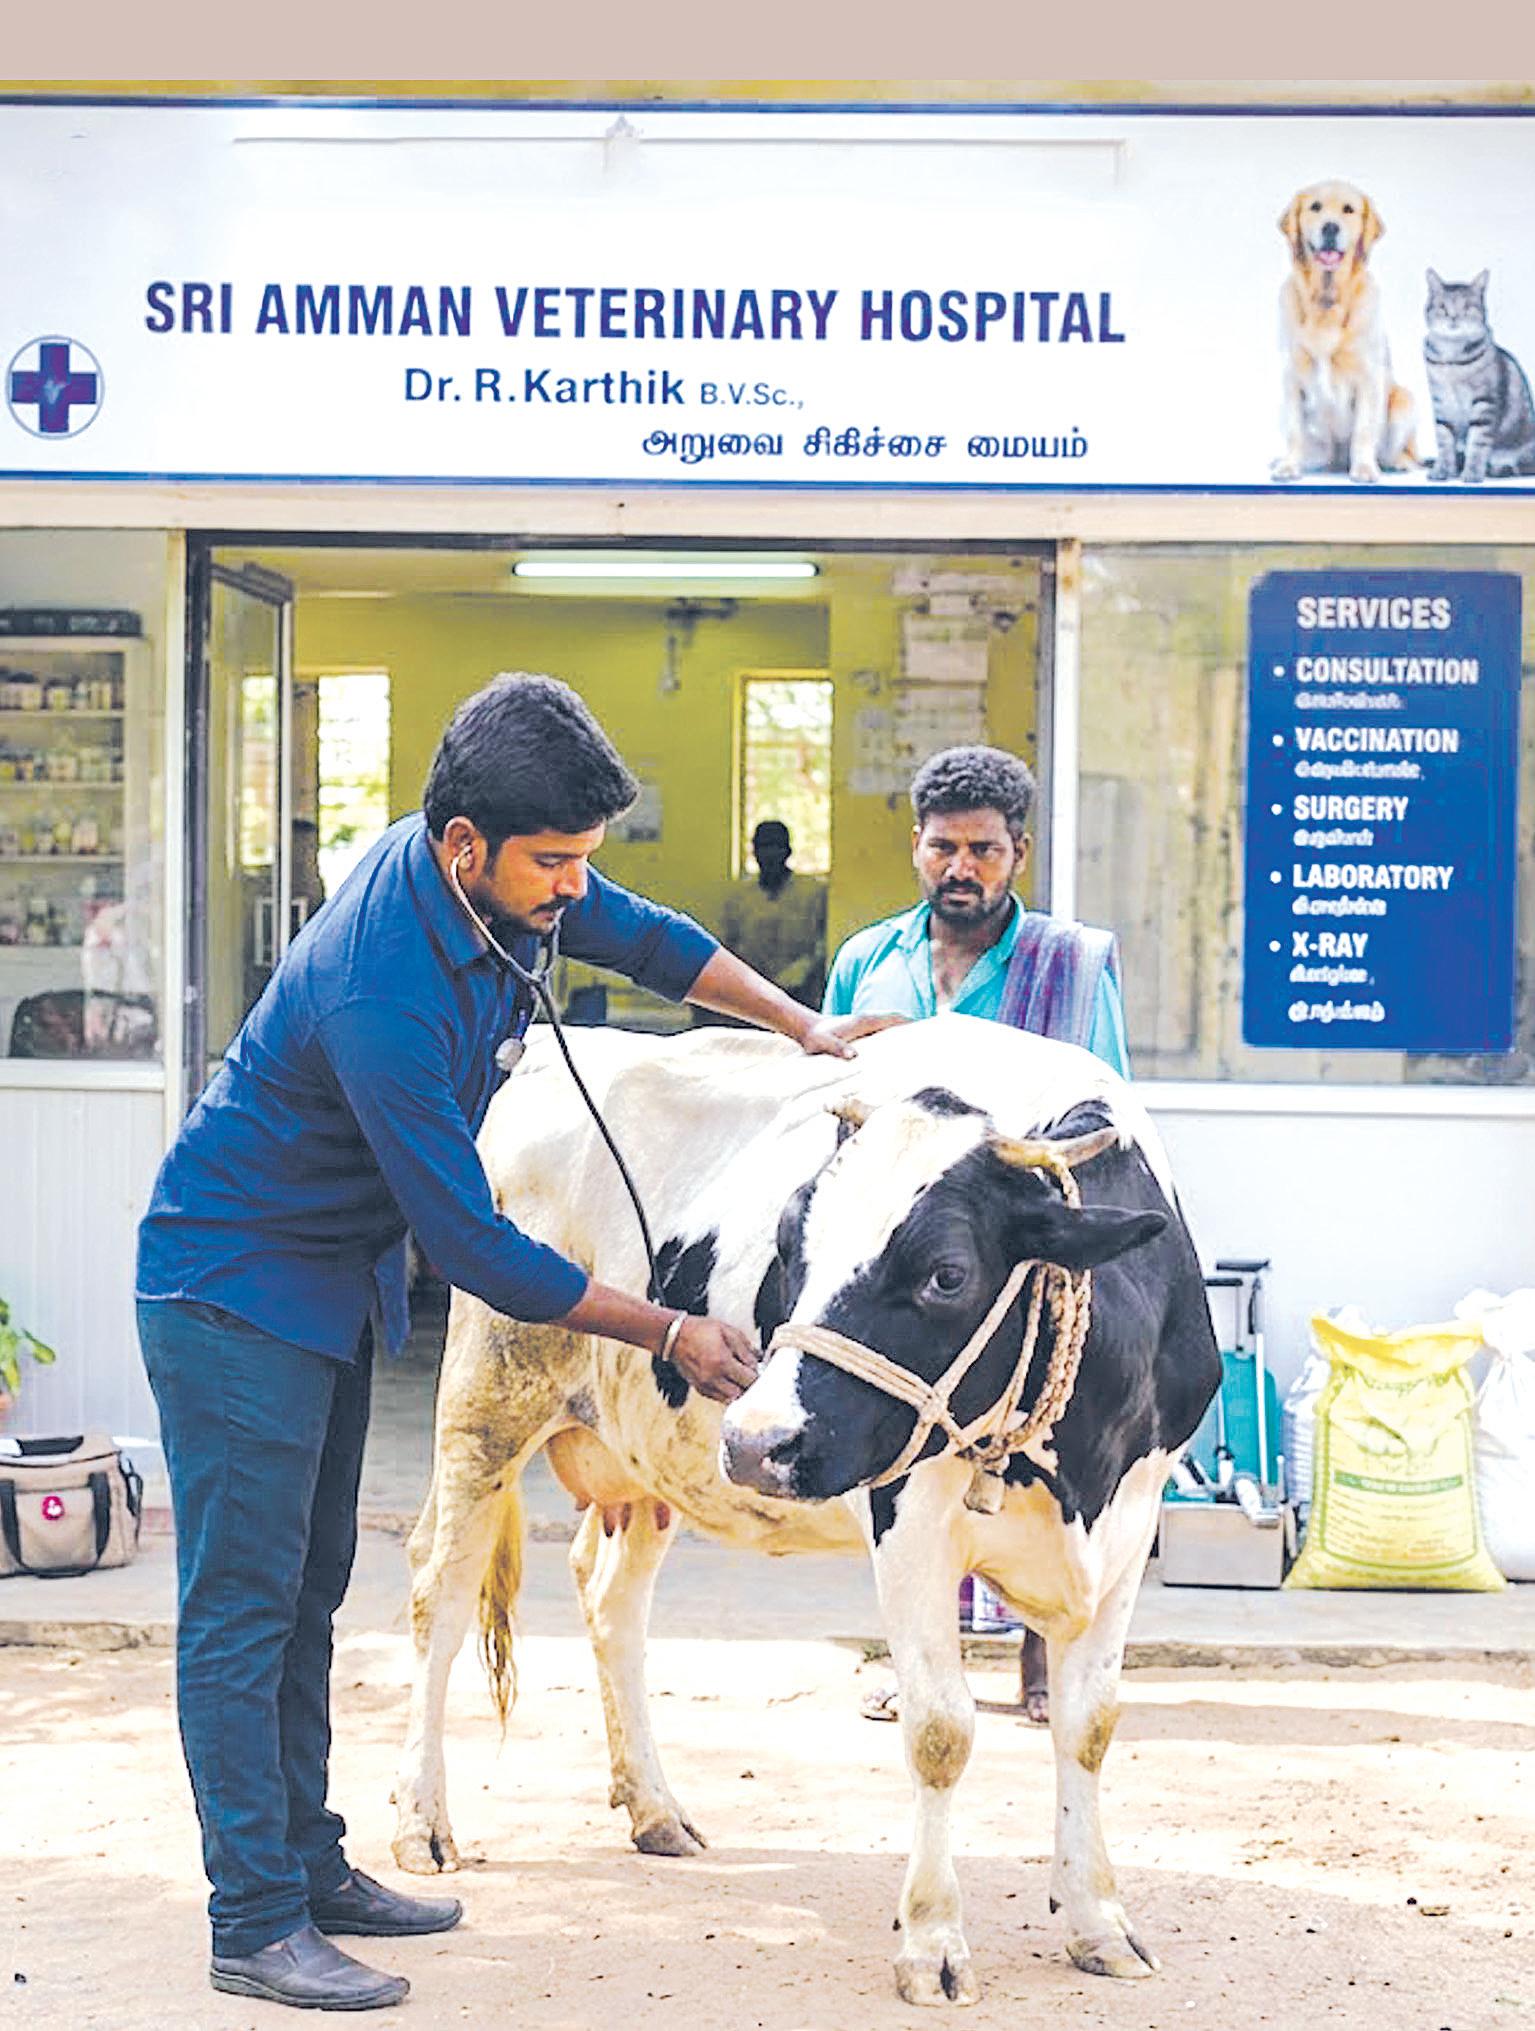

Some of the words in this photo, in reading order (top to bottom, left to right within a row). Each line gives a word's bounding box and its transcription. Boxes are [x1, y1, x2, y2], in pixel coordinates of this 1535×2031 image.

[145, 281, 232, 333] SRI
[256, 284, 471, 336] AMMAN
[495, 286, 838, 340] VETERINARY
[861, 290, 1125, 343] HOSPITAL
[405, 368, 460, 402] Dr.
[700, 382, 804, 410] B.V.Sc.,
[642, 429, 783, 464] அறுவை
[803, 426, 947, 458] சிகிச்சை
[967, 426, 1089, 459] மையம்
[1297, 597, 1452, 630] SERVICES
[1296, 656, 1479, 685] CONSULTATION
[1295, 727, 1459, 753] VACCINATION
[1294, 794, 1409, 821] SURGERY
[1292, 863, 1454, 890] LABORATORY
[1292, 931, 1369, 958] X-RAY
